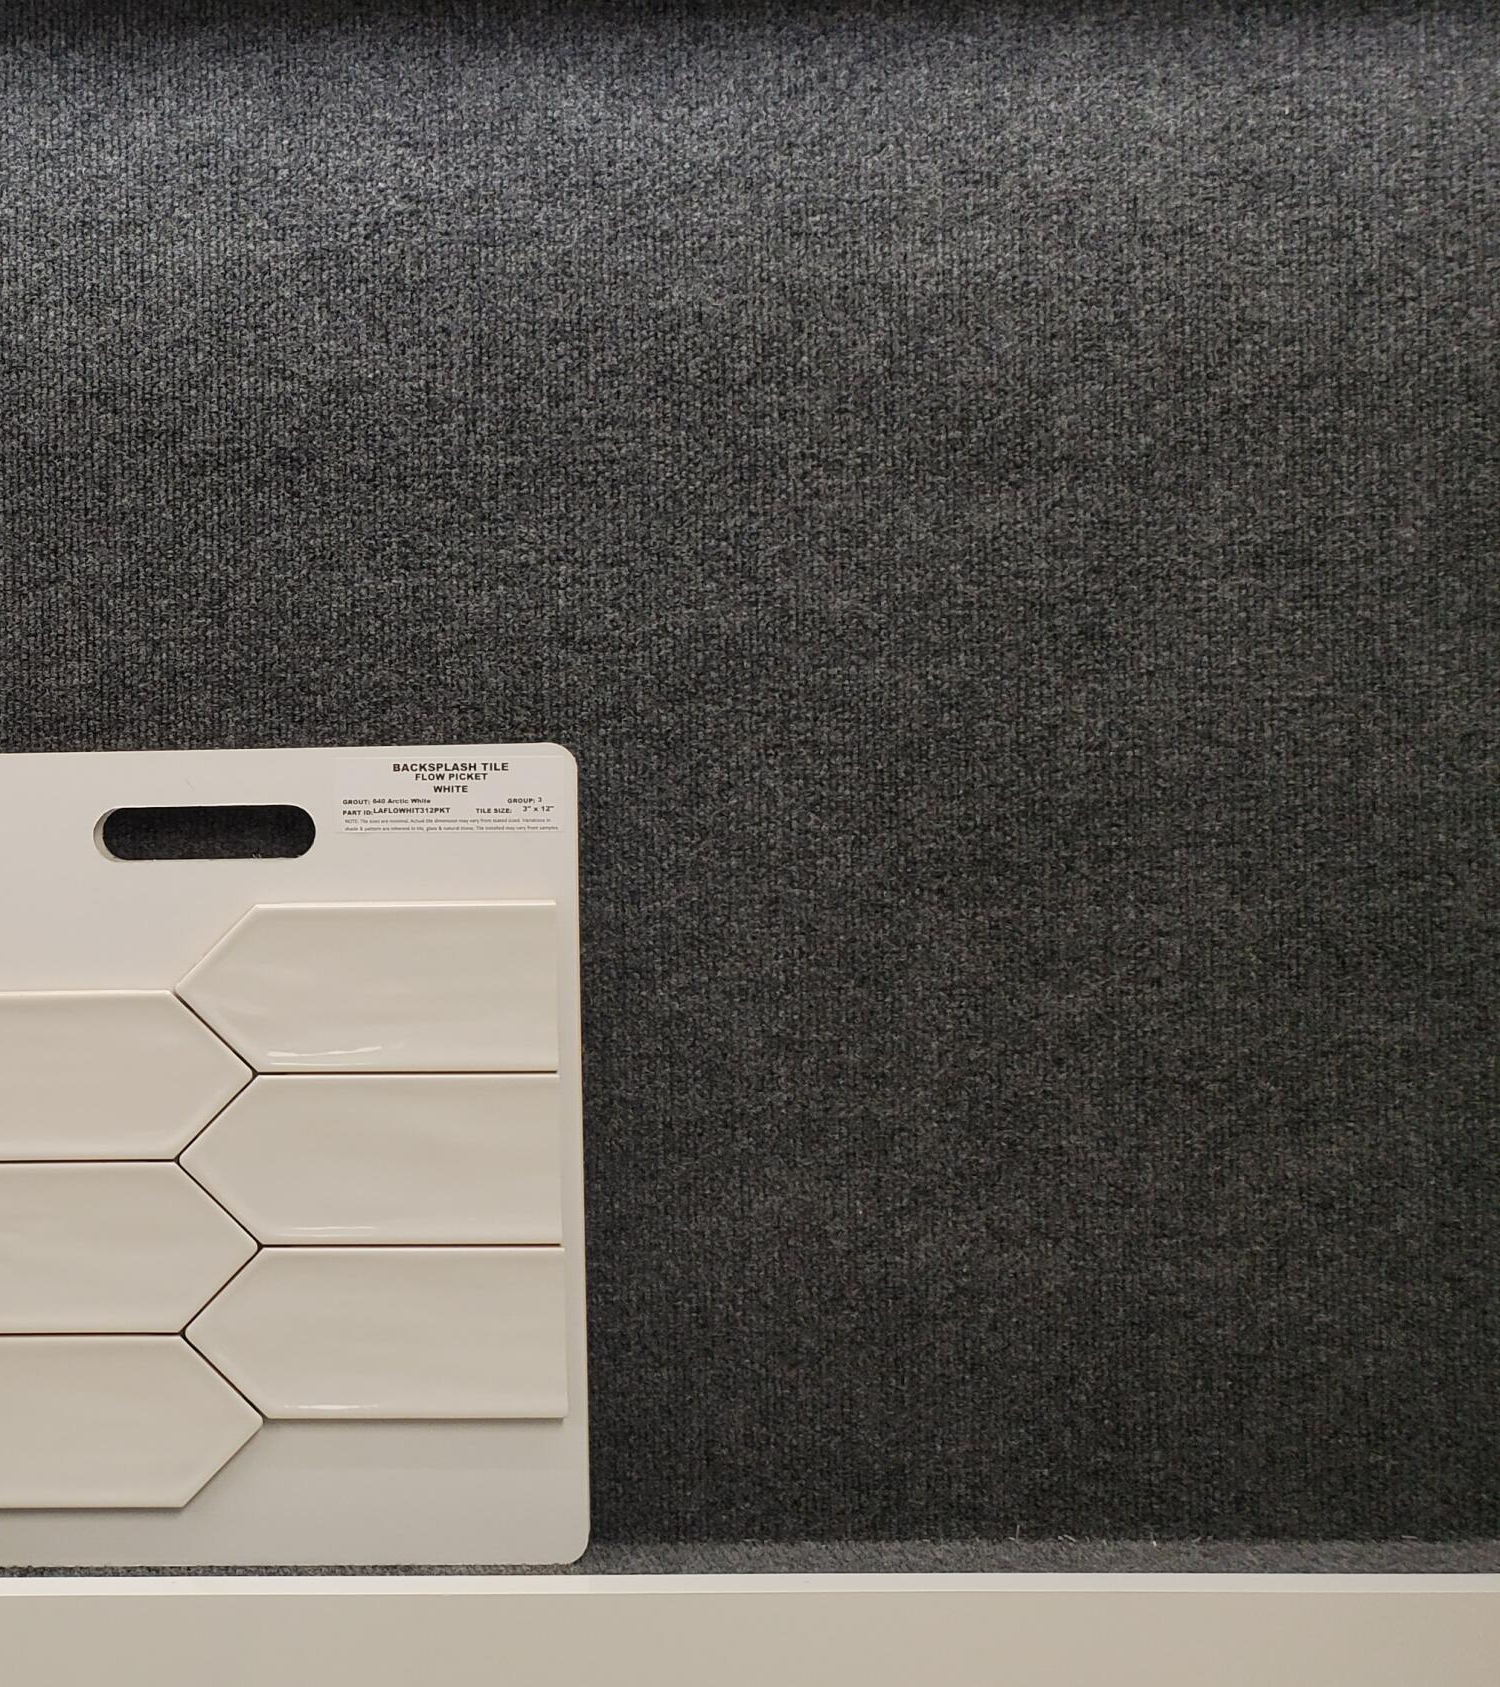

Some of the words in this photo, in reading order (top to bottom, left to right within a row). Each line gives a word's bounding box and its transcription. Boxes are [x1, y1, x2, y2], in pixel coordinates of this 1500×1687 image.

[392, 763, 477, 772] BACKSPLASH
[480, 762, 509, 771] TILE
[415, 773, 445, 781] FLOW
[433, 785, 468, 793] WHITE
